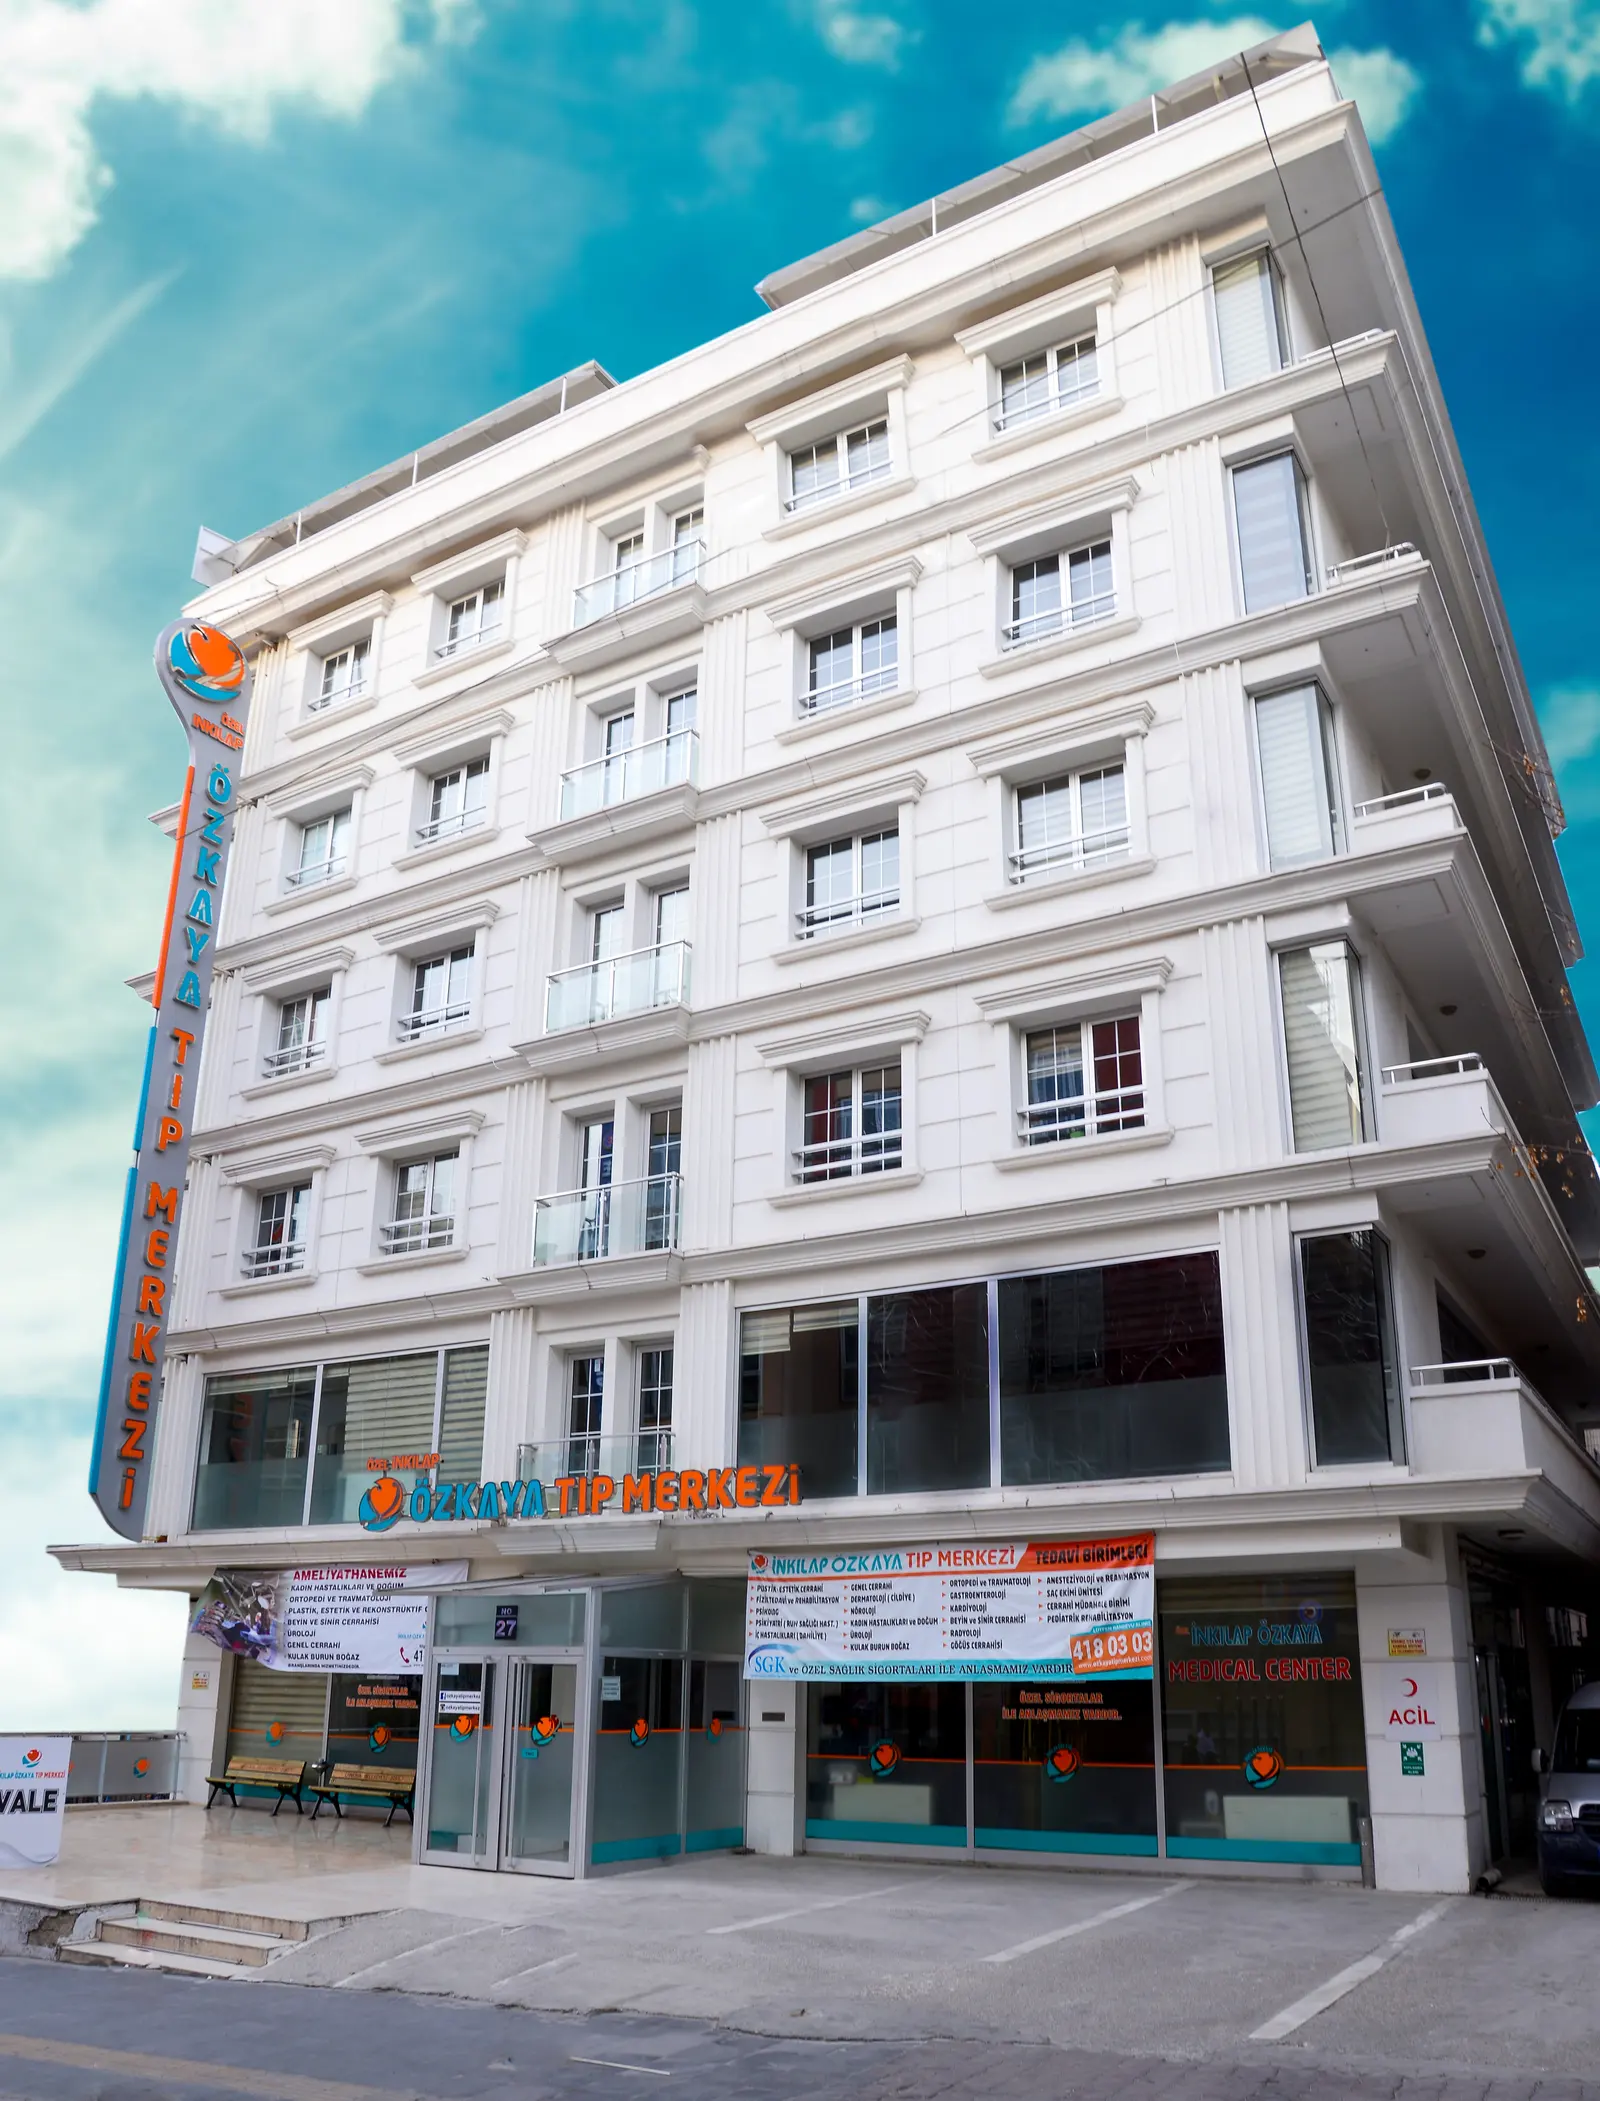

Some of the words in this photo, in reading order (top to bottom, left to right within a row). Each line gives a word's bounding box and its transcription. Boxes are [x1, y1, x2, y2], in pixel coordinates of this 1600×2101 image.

[173, 763, 232, 1009] ÖZKAYA
[155, 1027, 196, 1153] TIP
[367, 1457, 388, 1471] ÖZEL
[409, 1477, 545, 1522] ÖZKAYA
[554, 1475, 615, 1516] TIP
[621, 1464, 801, 1514] MERKEZİ
[772, 1555, 829, 1576] İNKILAP
[831, 1552, 903, 1573] ÖZKAYA
[906, 1551, 932, 1568] TIP
[937, 1545, 1015, 1567] MERKEZİ
[1035, 1545, 1079, 1564] TEDAVİ
[1083, 1541, 1148, 1562] BİRİMLERİ
[293, 1566, 407, 1581] AMELİYATHANEMİZ
[1046, 1573, 1095, 1585] ANESTEZİYOLOJİ
[850, 1583, 867, 1591] GENEL
[868, 1580, 892, 1591] CERRAHİ
[949, 1577, 979, 1587] ORTOPEDİ
[988, 1575, 1031, 1587] TRAVMATOLOJİ
[800, 1583, 823, 1592] CERRAHİ
[1046, 1589, 1058, 1598] SAÇ
[1059, 1588, 1076, 1597] EKİMİ
[1078, 1586, 1103, 1596] ÜNİTESİ
[289, 1595, 325, 1603] ORTOPEDİ
[850, 1593, 886, 1603] DERMATOLOJİ
[950, 1588, 1006, 1600] GASTROENTEROLOJİ
[950, 1602, 987, 1613] KARDİYOLOJİ
[1047, 1600, 1074, 1610] CERRAHİ
[1108, 1597, 1130, 1608] BİRİMİ
[321, 1606, 350, 1614] ESTETİK
[363, 1605, 422, 1613] REKONSTRÜKTİF
[850, 1606, 876, 1616] NÖROLOJİ
[288, 1618, 308, 1626] BEYİN
[850, 1619, 868, 1627] KADIN
[868, 1618, 908, 1626] HASTALIKLARI
[917, 1616, 938, 1625] DOĞUM
[950, 1614, 968, 1624] BEYİN
[977, 1614, 994, 1624] SİNİR
[995, 1613, 1026, 1624] CERRAHİSİ
[1047, 1613, 1080, 1623] PEDİATRİK
[496, 1620, 517, 1637] 27
[950, 1627, 981, 1638] RADYOLOJİ
[1191, 1621, 1252, 1646] İNKILAP
[1257, 1618, 1322, 1645] ÖZKAYA
[850, 1629, 872, 1640] ÜROLOJİ
[311, 1641, 341, 1649] CERRAHİ
[850, 1643, 869, 1651] KULAK
[869, 1643, 890, 1651] BURUN
[891, 1641, 910, 1650] BOĞAZ
[950, 1640, 970, 1649] GÖĞÜS
[971, 1639, 1002, 1649] CERRAHİSİ
[1073, 1637, 1104, 1660] 418
[1107, 1634, 1128, 1657] 03
[1132, 1631, 1152, 1653] 03
[336, 1653, 360, 1661] BOĞAZ
[754, 1656, 786, 1673] SGK
[801, 1663, 826, 1675] ÖZEL
[829, 1663, 865, 1675] SAĞLIK
[868, 1662, 936, 1675] SİGORTALARI
[938, 1662, 956, 1674] İLE
[959, 1664, 1029, 1676] ANLAŞMAMIZ
[1032, 1663, 1073, 1674] VARDIR
[1168, 1658, 1260, 1683] MEDICAL
[1265, 1657, 1352, 1682] CENTER
[1388, 1705, 1435, 1725] ACİL
